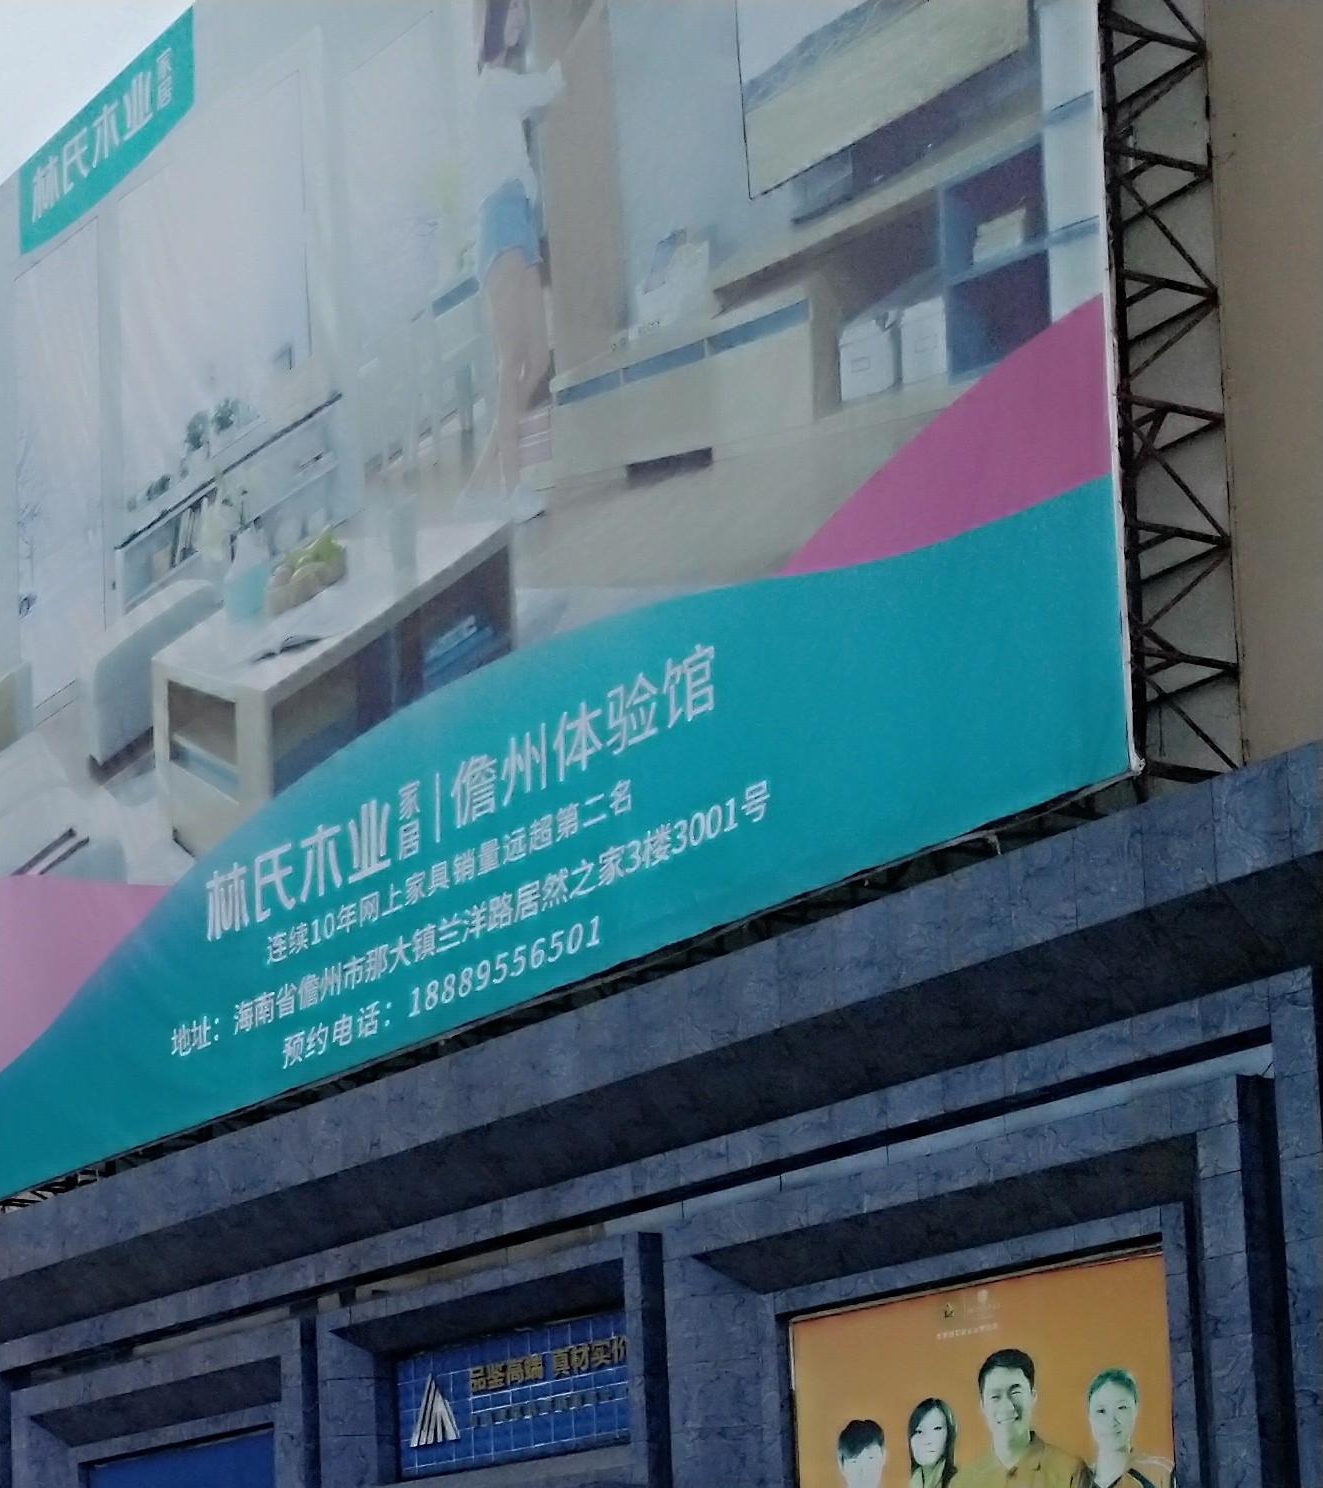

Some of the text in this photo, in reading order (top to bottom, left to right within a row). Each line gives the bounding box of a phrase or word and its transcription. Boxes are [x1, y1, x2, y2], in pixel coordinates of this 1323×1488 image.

[31, 70, 154, 224] 林氏木业
[206, 799, 392, 942] 林氏木业
[450, 643, 717, 829] 儋州体验馆
[266, 778, 634, 965] 连续10年网上家具销量远超第二名
